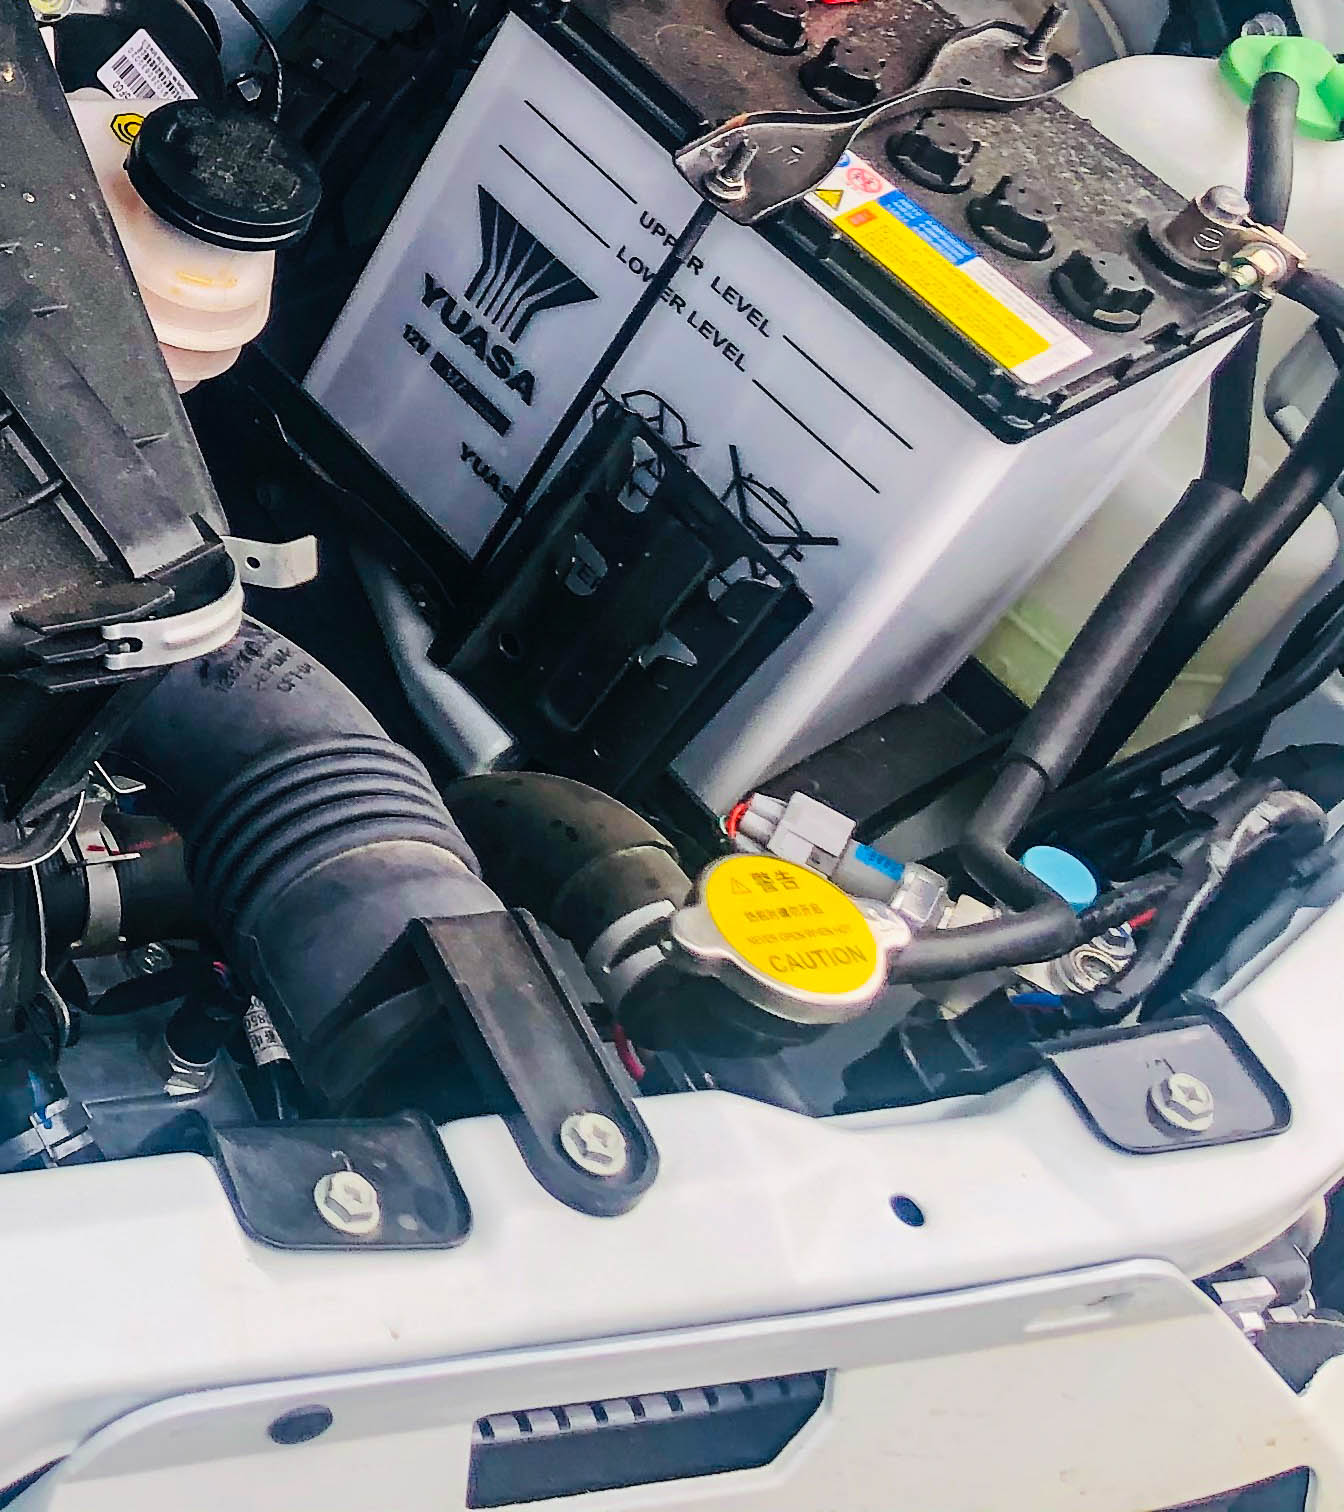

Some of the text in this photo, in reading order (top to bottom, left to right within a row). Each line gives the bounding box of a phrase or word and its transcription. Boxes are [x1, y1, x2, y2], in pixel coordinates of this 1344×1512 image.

[638, 209, 772, 339] UPPR LEVEL
[401, 322, 433, 360] 12V
[418, 272, 537, 407] YUASA
[687, 307, 749, 373] LEVEL
[458, 442, 520, 501] YUAS
[751, 869, 801, 894] 警告
[768, 944, 869, 973] CAUTION
